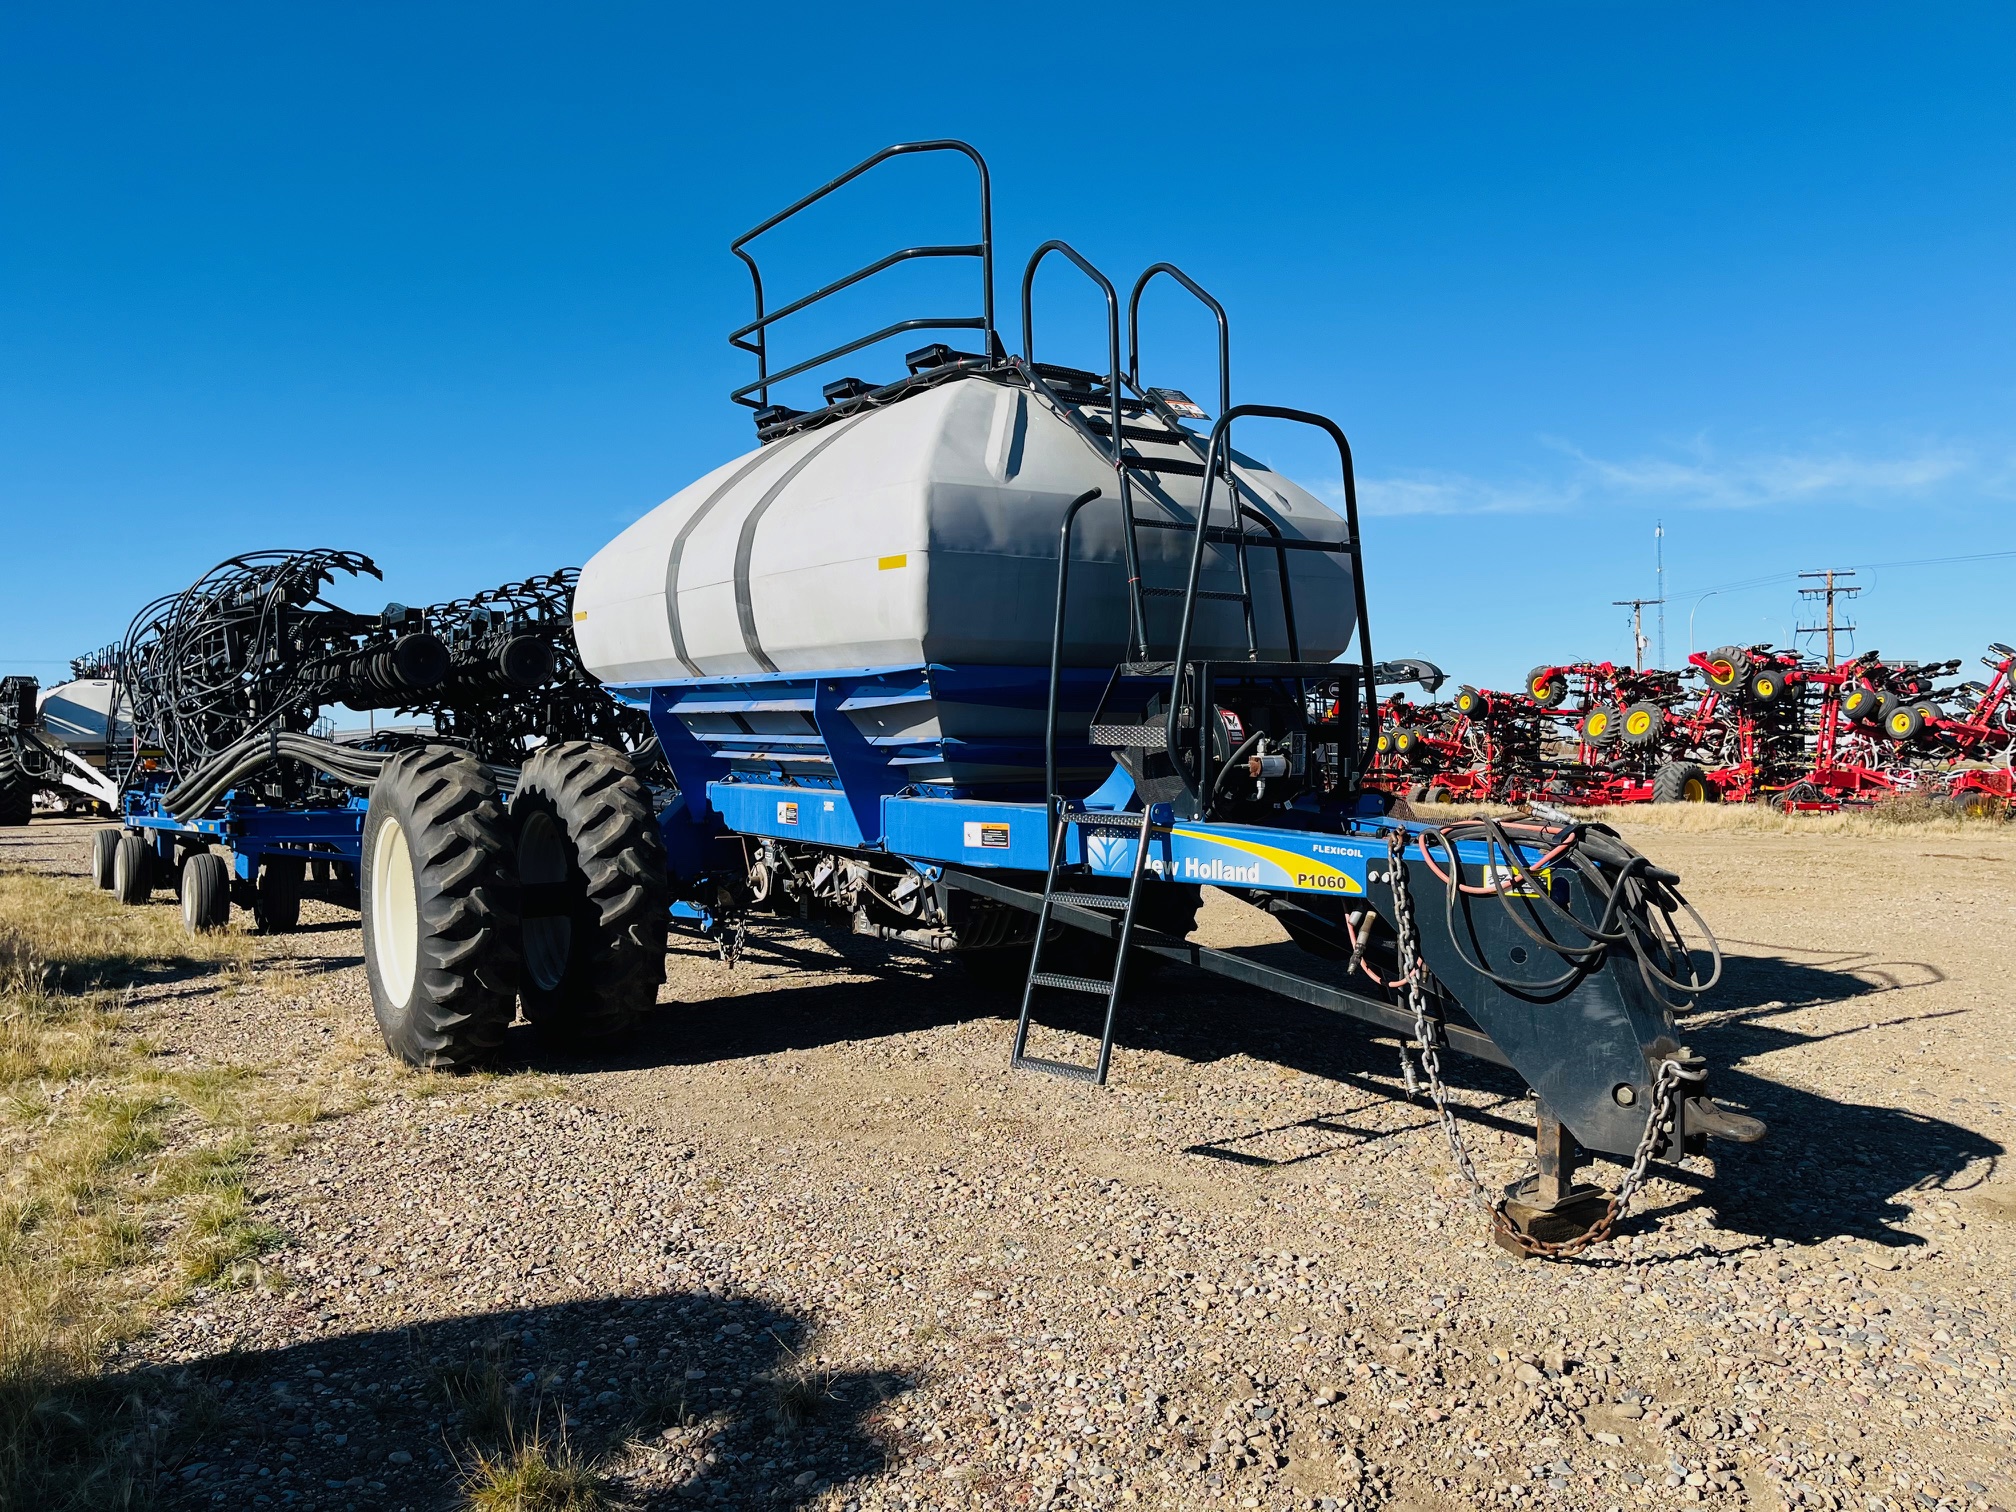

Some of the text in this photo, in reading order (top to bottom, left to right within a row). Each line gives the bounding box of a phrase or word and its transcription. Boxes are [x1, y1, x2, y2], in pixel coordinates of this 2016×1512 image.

[1312, 844, 1364, 858] FLEXICOIL
[1185, 857, 1260, 883] Holland
[1297, 873, 1346, 890] P1060
